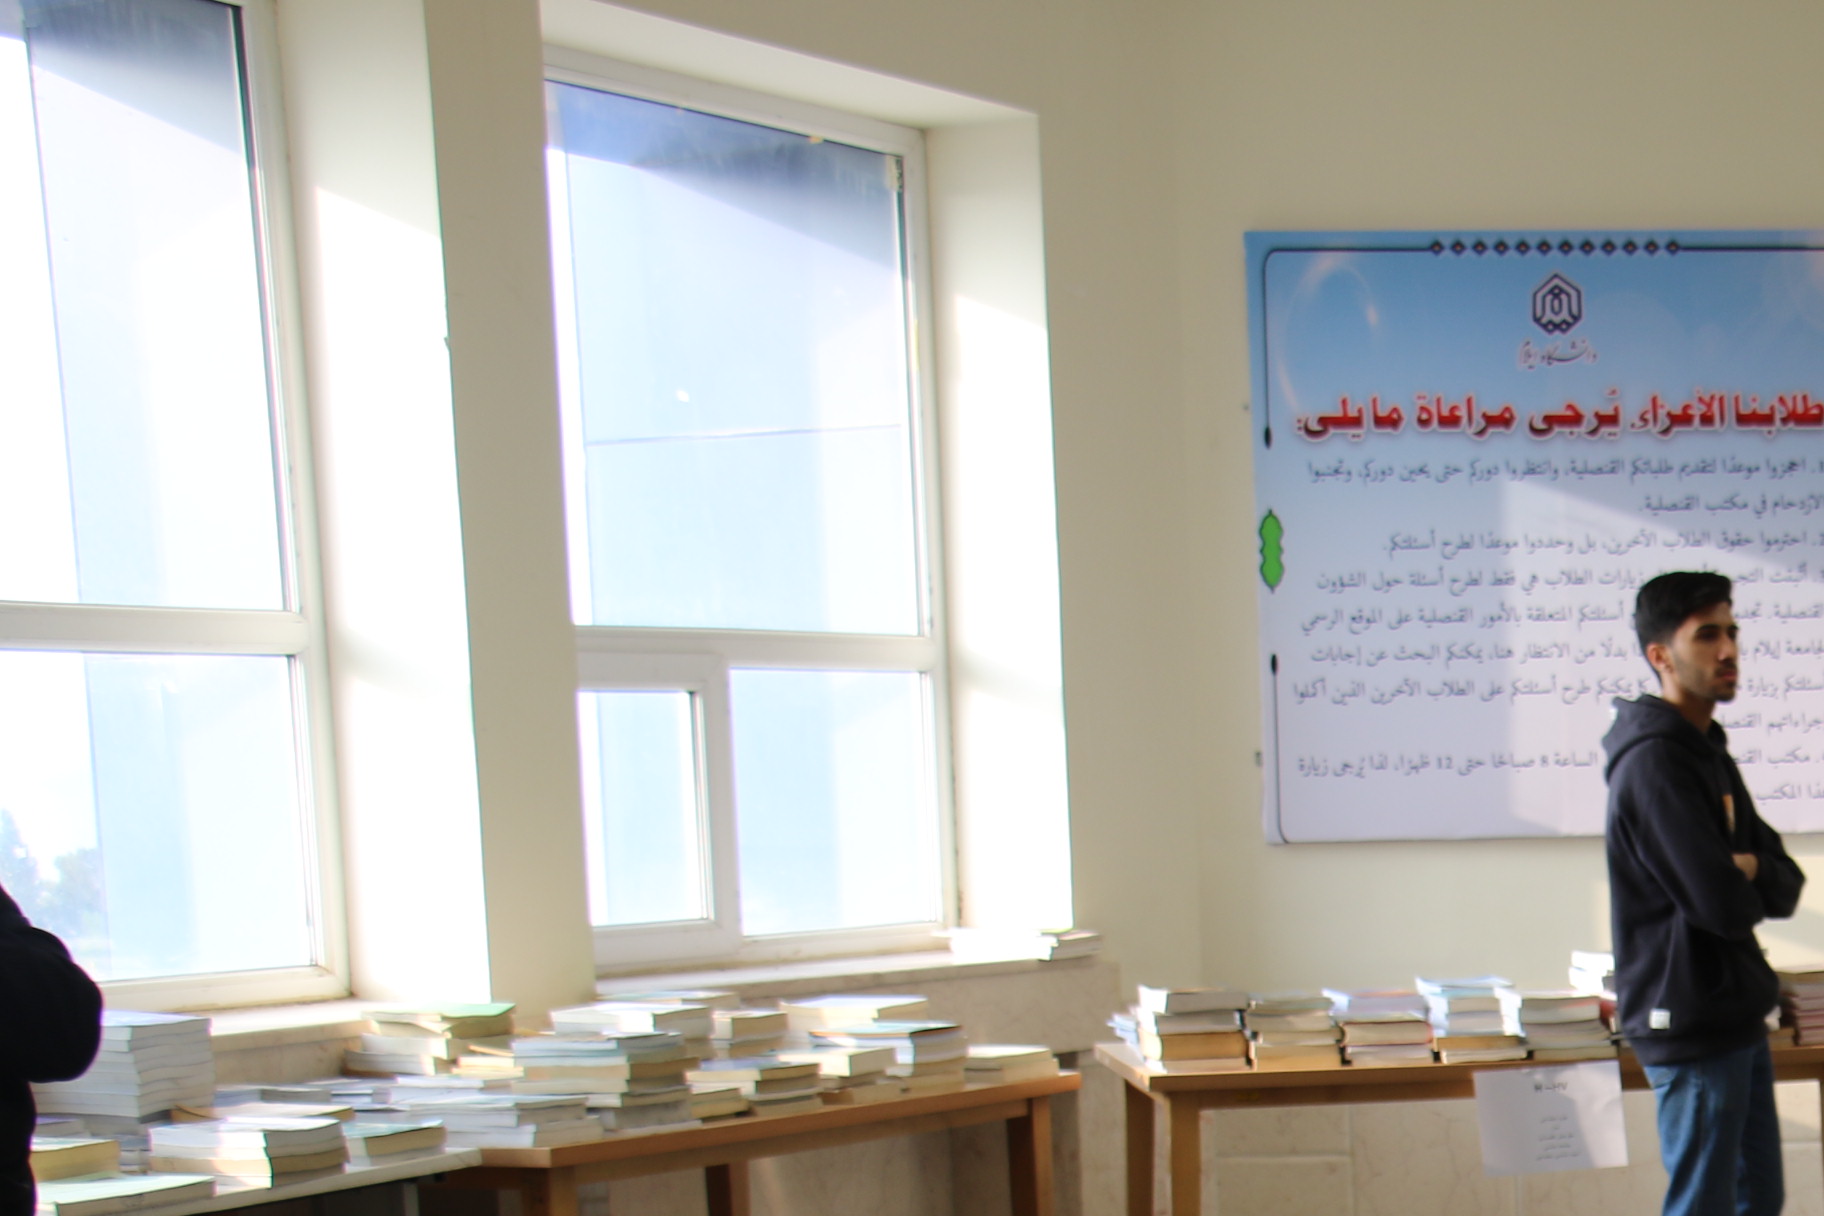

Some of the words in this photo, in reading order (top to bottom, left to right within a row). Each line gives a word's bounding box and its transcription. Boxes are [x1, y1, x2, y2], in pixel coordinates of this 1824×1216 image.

[1371, 394, 1405, 432] ما
[1416, 393, 1517, 438] مراعاة
[1704, 494, 1749, 514] مكتب
[1766, 747, 1812, 770] مكتب
